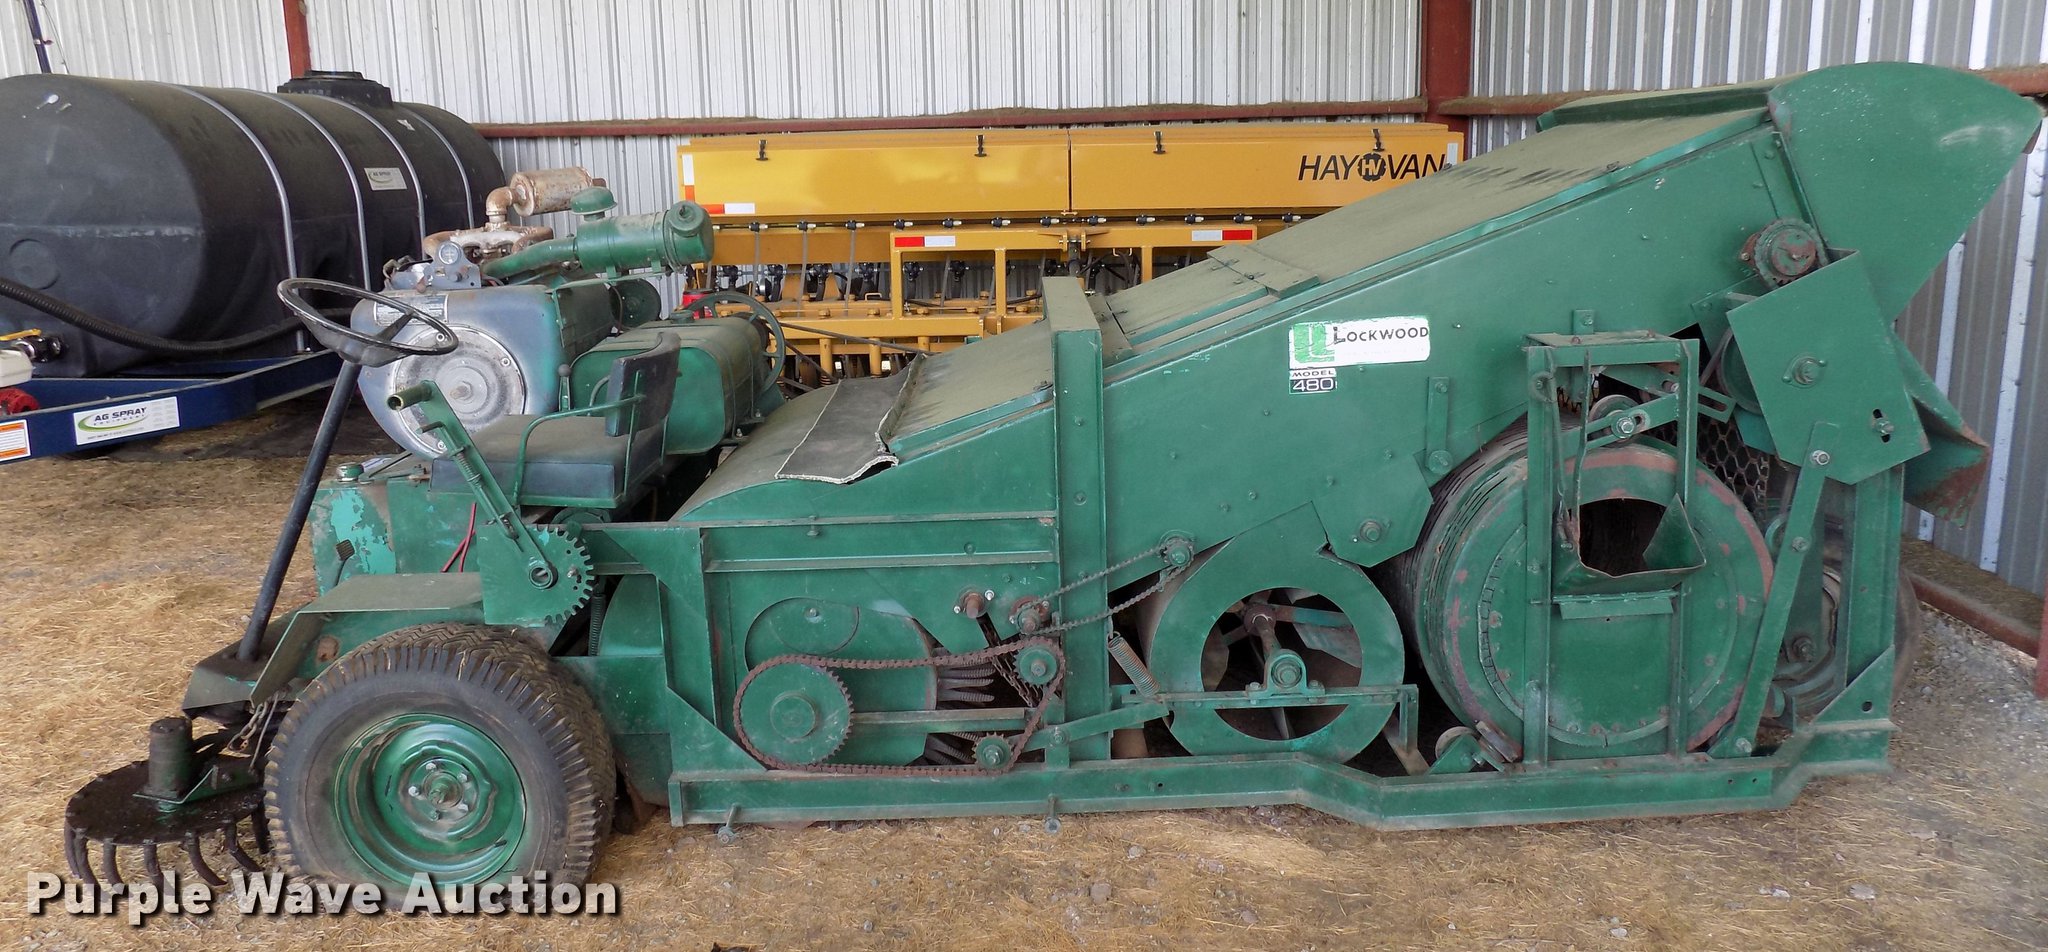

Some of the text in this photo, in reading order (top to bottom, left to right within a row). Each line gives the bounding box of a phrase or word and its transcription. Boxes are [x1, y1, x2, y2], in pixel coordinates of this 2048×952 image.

[1298, 154, 1360, 181] HAY
[1388, 153, 1446, 180] VAN
[1333, 326, 1429, 344] LOCKWOOD
[1292, 369, 1335, 378] MODEL
[1292, 377, 1335, 392] 480
[94, 407, 147, 422] AG SPRAY
